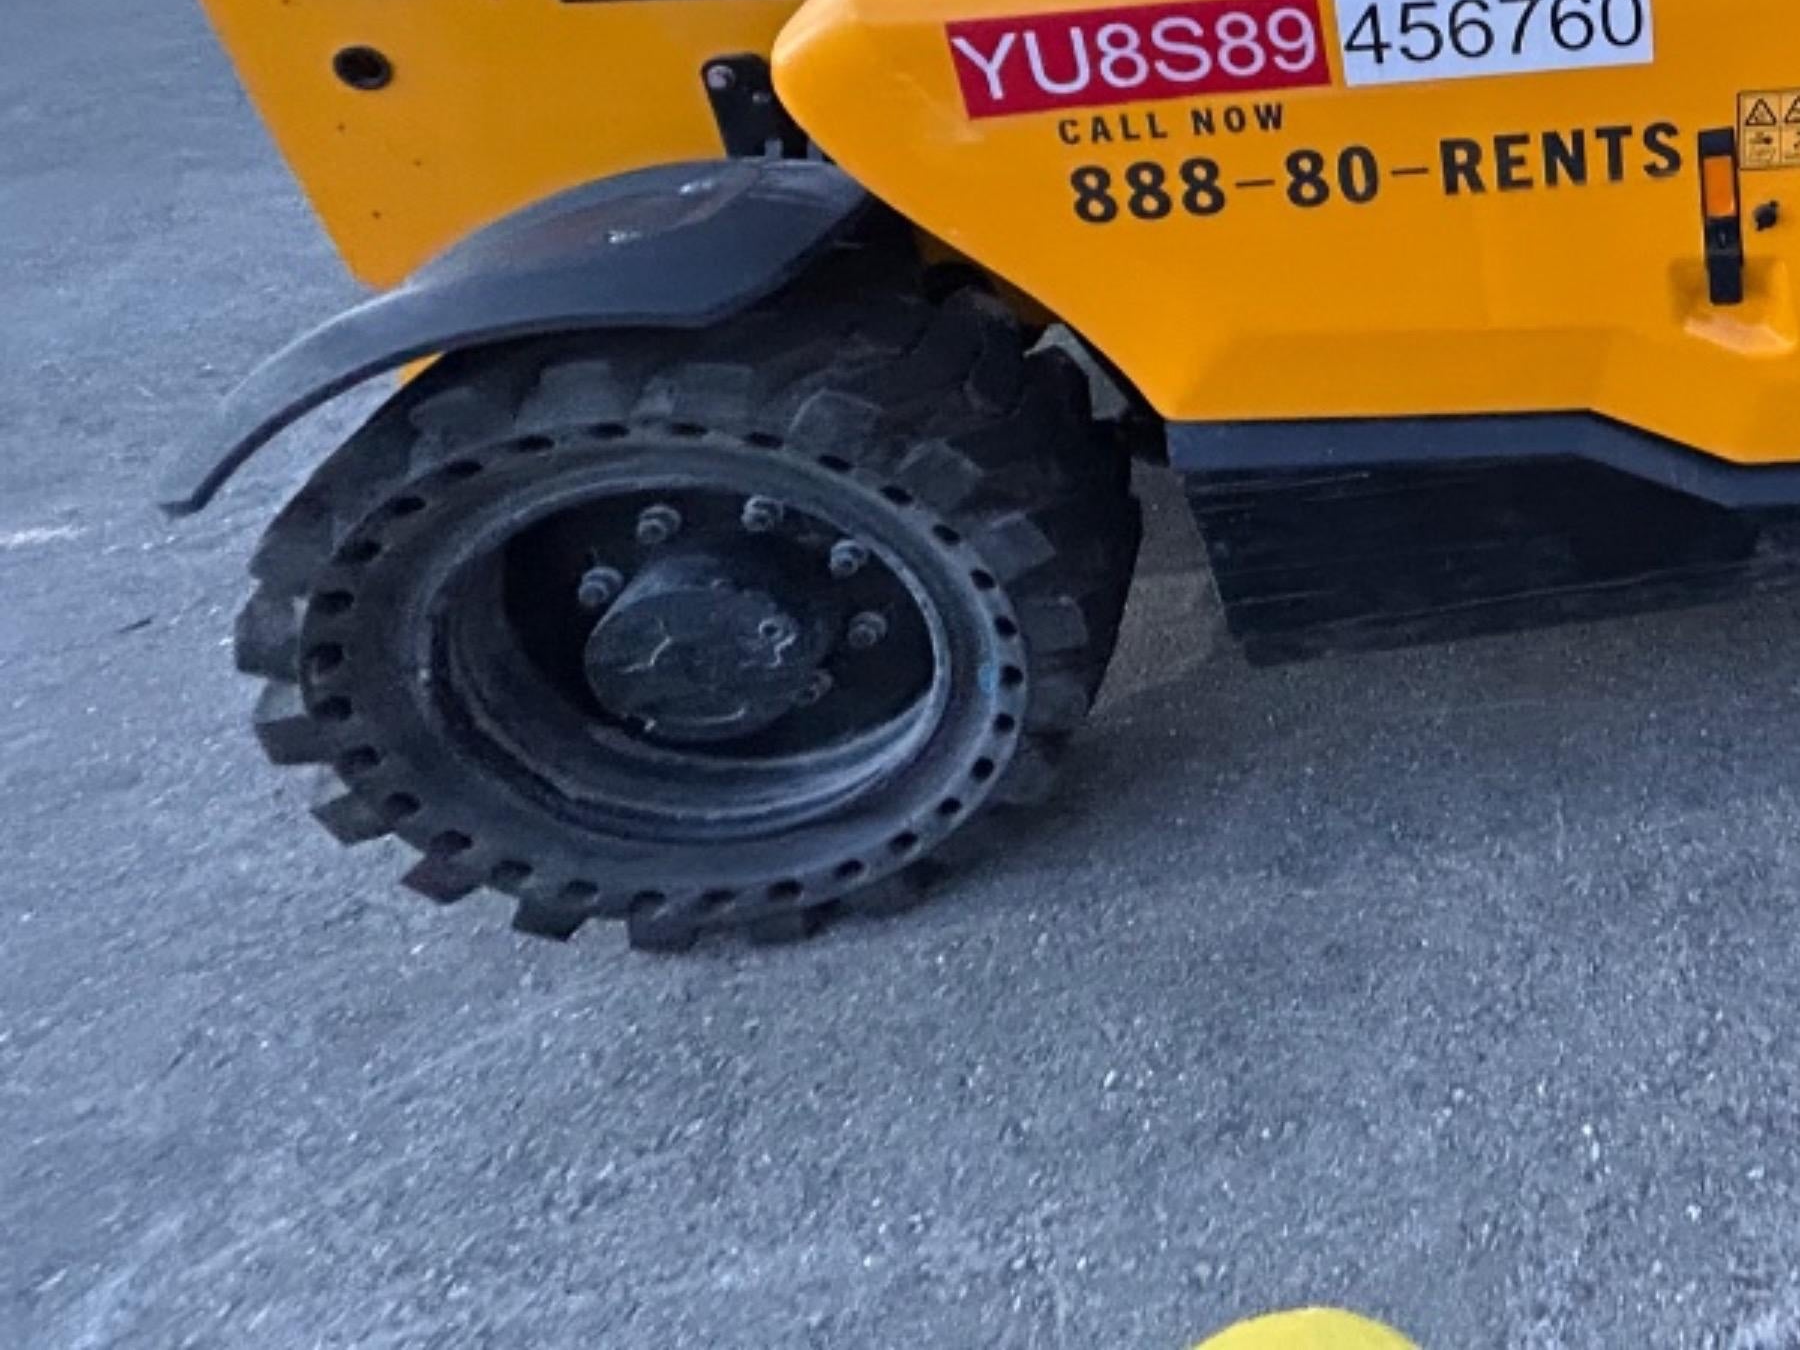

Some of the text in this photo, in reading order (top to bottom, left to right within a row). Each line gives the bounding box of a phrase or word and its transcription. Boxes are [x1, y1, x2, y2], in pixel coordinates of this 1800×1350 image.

[952, 7, 1316, 100] YU8S89
[1058, 103, 1287, 145] CALL NOW
